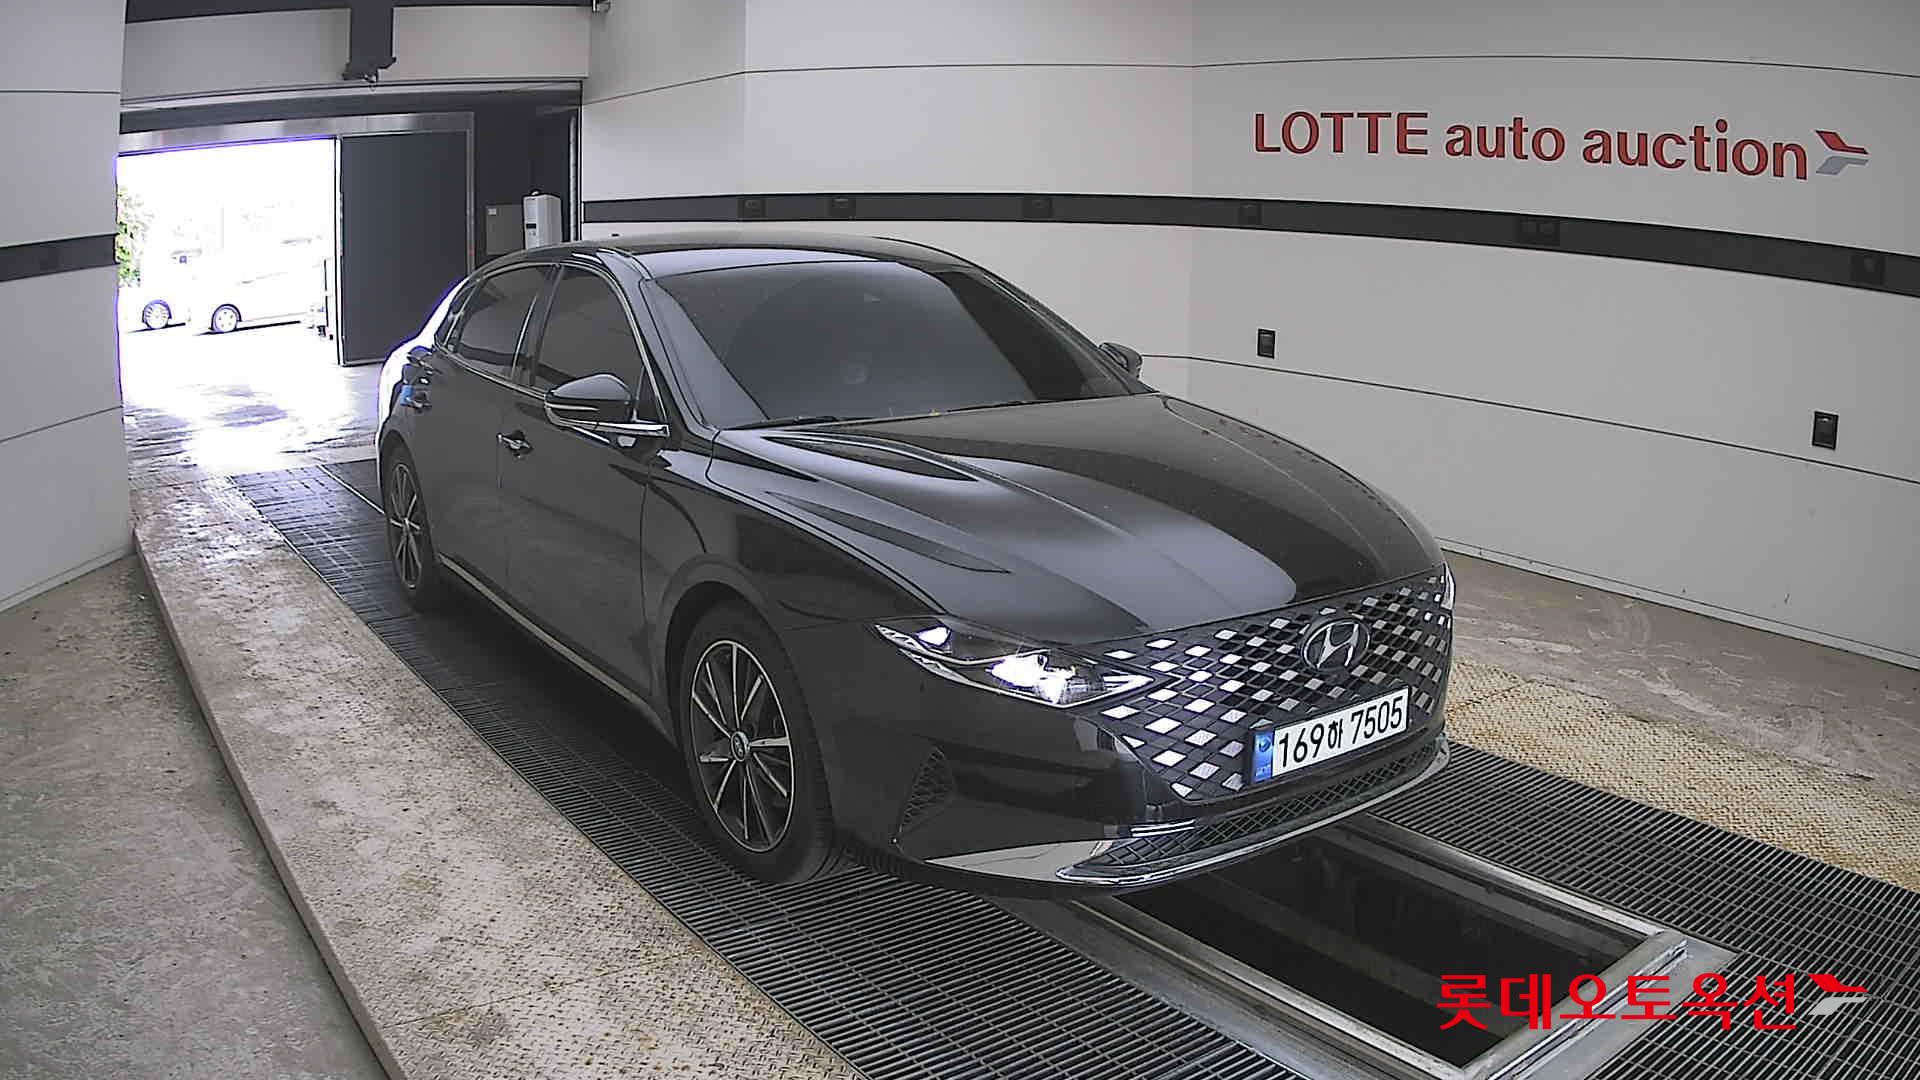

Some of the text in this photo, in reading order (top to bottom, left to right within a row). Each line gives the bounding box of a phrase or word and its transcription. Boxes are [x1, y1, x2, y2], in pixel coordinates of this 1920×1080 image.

[1254, 111, 1809, 181] LOTTE auto auction
[1278, 695, 1404, 768] 169하 7505
